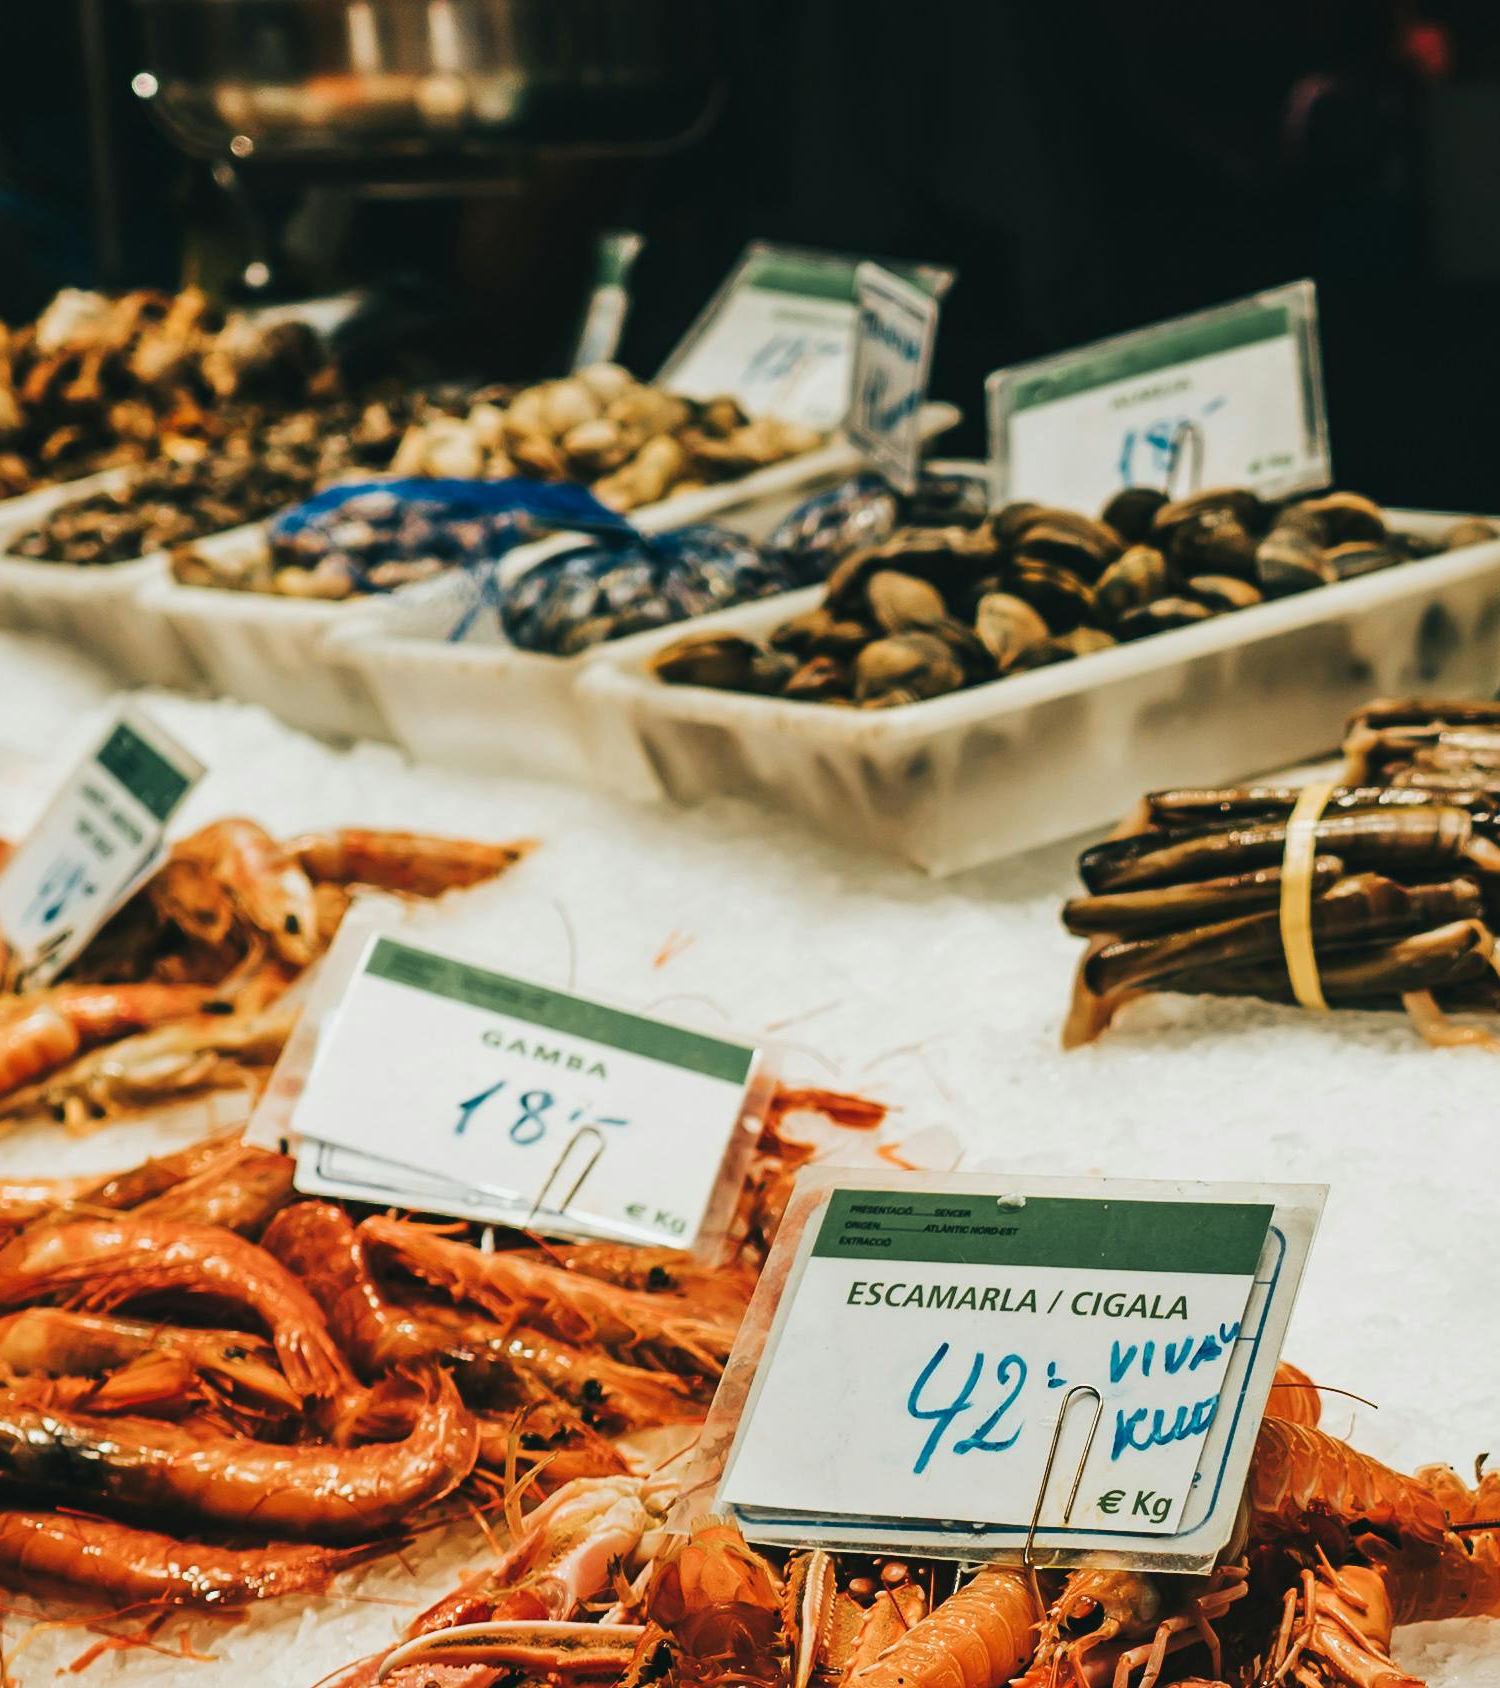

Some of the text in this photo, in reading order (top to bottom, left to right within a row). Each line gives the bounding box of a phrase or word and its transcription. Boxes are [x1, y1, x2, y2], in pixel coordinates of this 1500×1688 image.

[482, 1030, 608, 1080] GAMBA
[653, 1210, 687, 1236] Kg
[846, 1280, 1190, 1321] ESCAMARLA / CIGALA
[1096, 1488, 1174, 1525] € Kg
